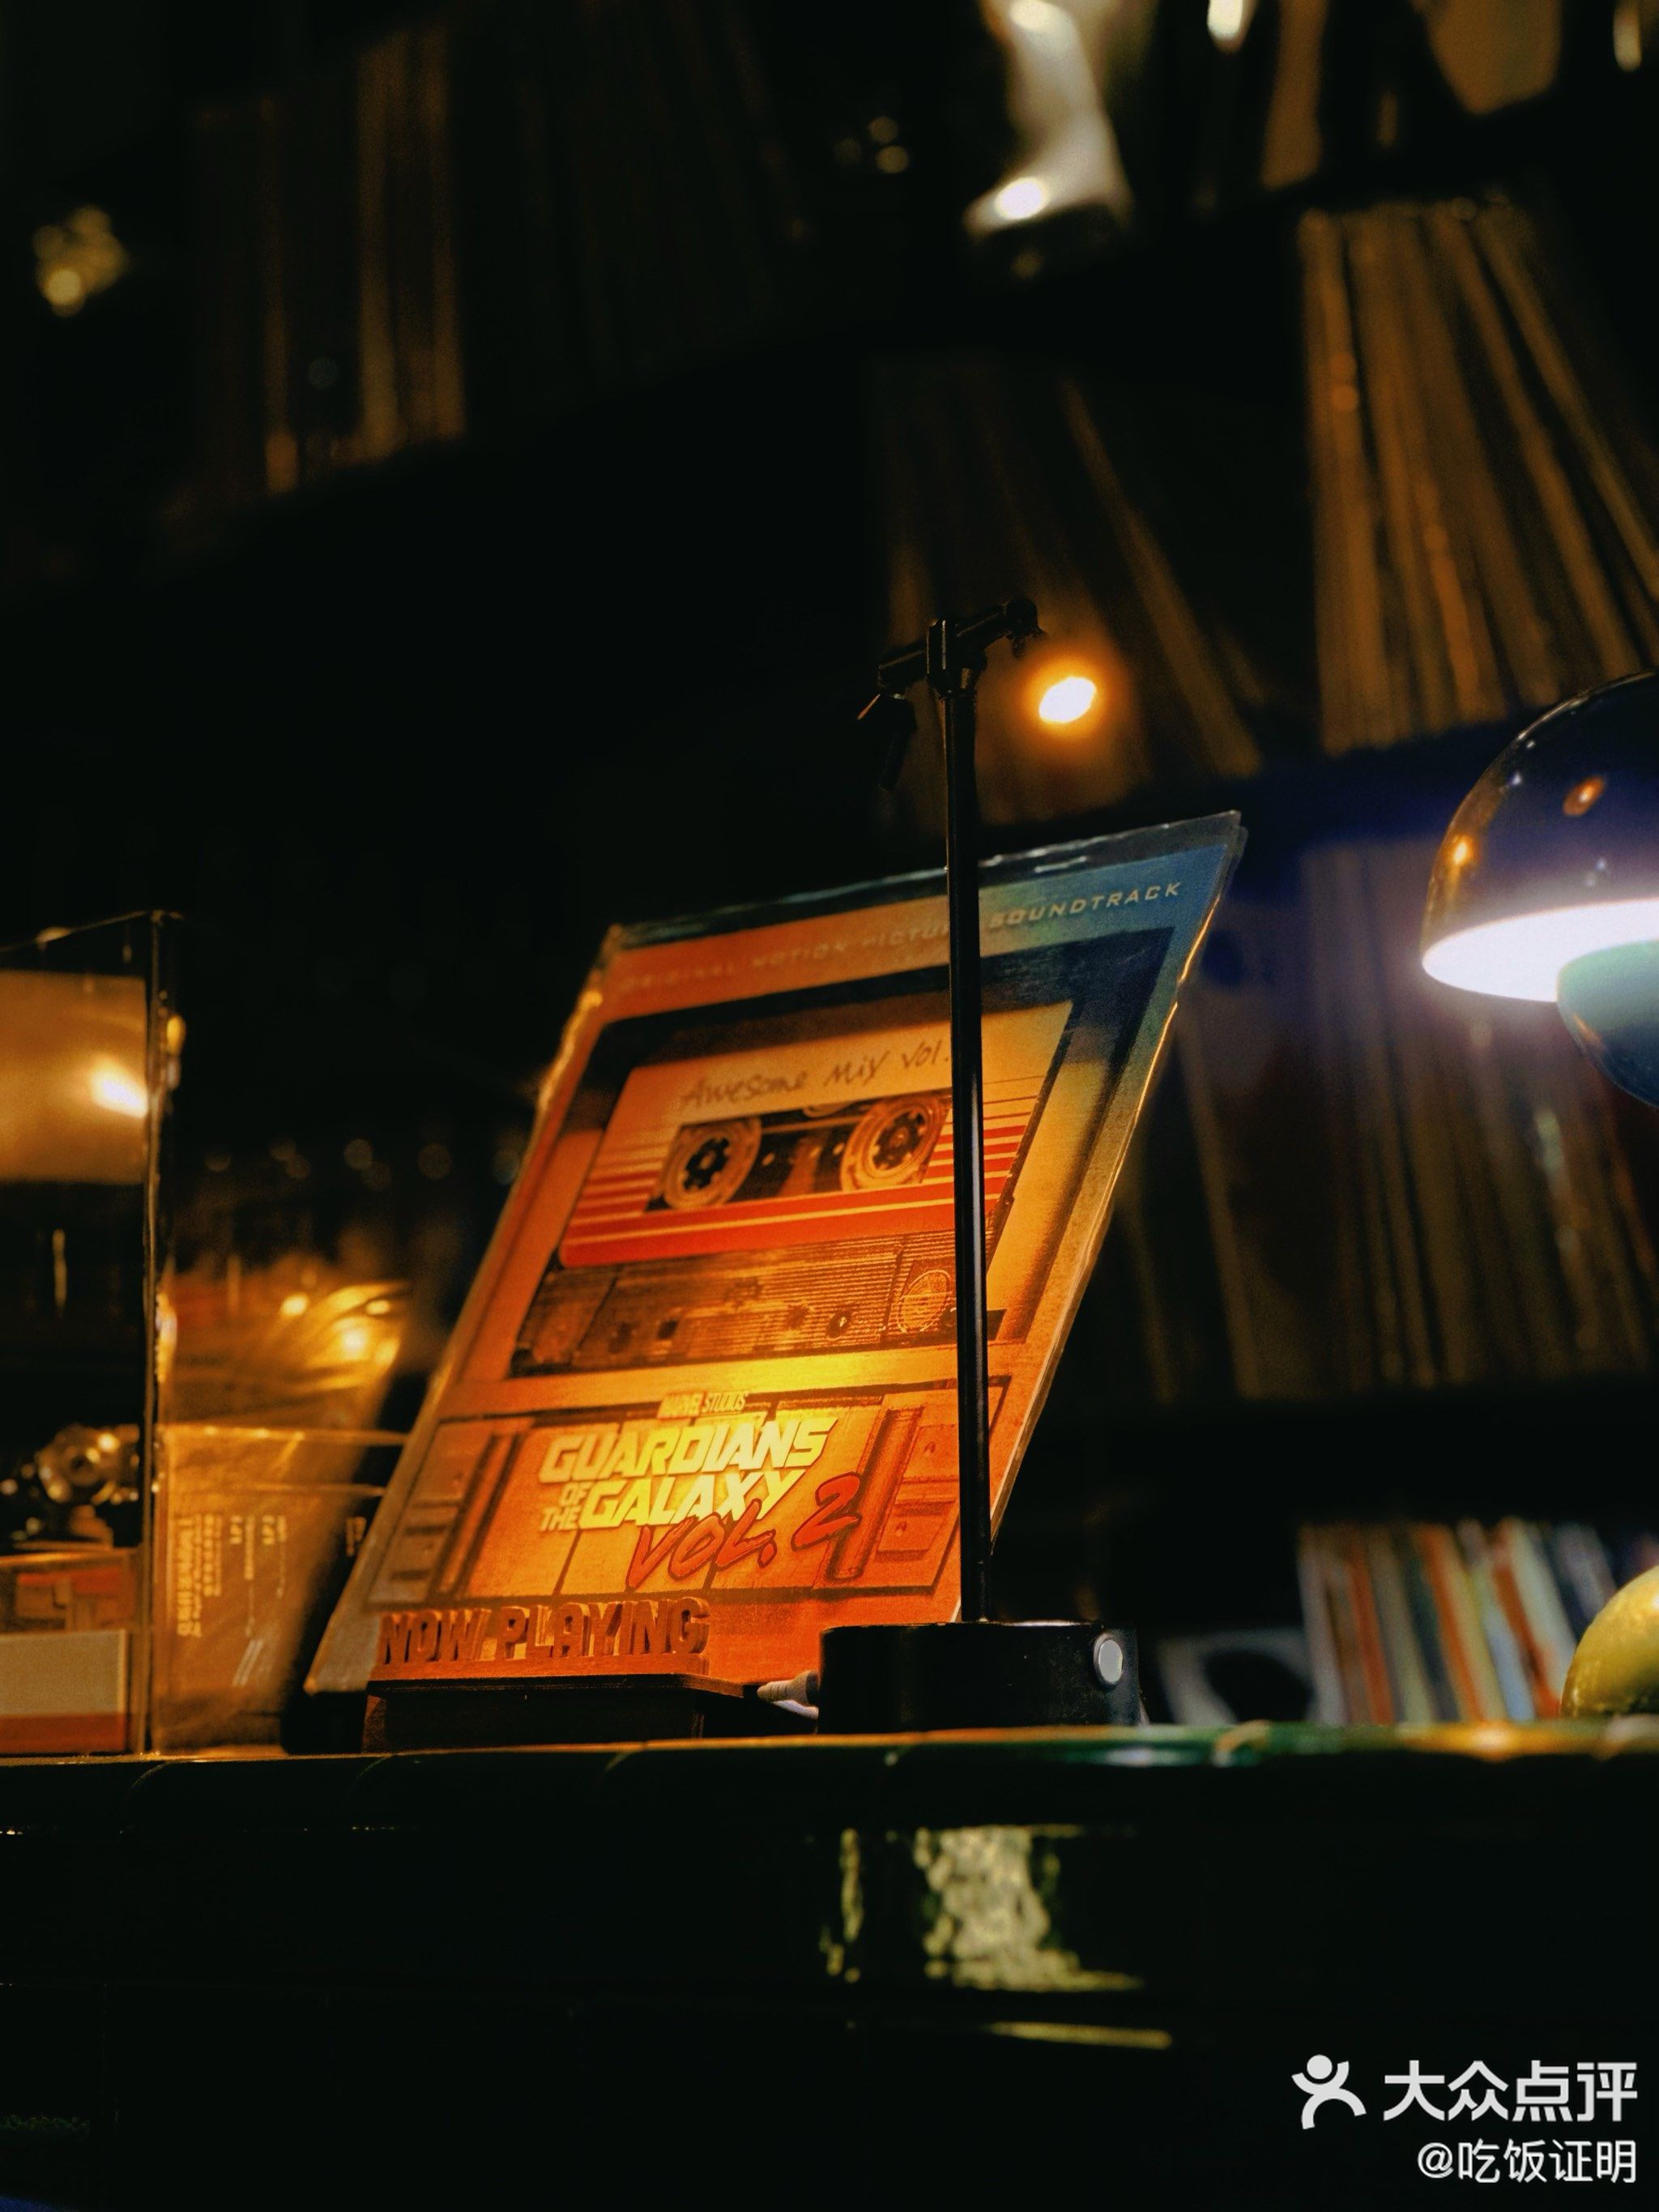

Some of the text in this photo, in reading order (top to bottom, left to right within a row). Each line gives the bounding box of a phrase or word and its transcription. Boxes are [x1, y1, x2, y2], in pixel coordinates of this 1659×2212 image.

[860, 922, 949, 947] PICTU
[987, 881, 1183, 929] SOUNDTRACK
[702, 1390, 750, 1413] STUDIOS
[539, 1416, 839, 1484] GUARDIANS
[539, 1469, 806, 1532] THE GALAXY
[561, 1481, 592, 1506] OF
[625, 1471, 862, 1591] VOL. 2
[381, 1596, 710, 1665] NOW PLAYING
